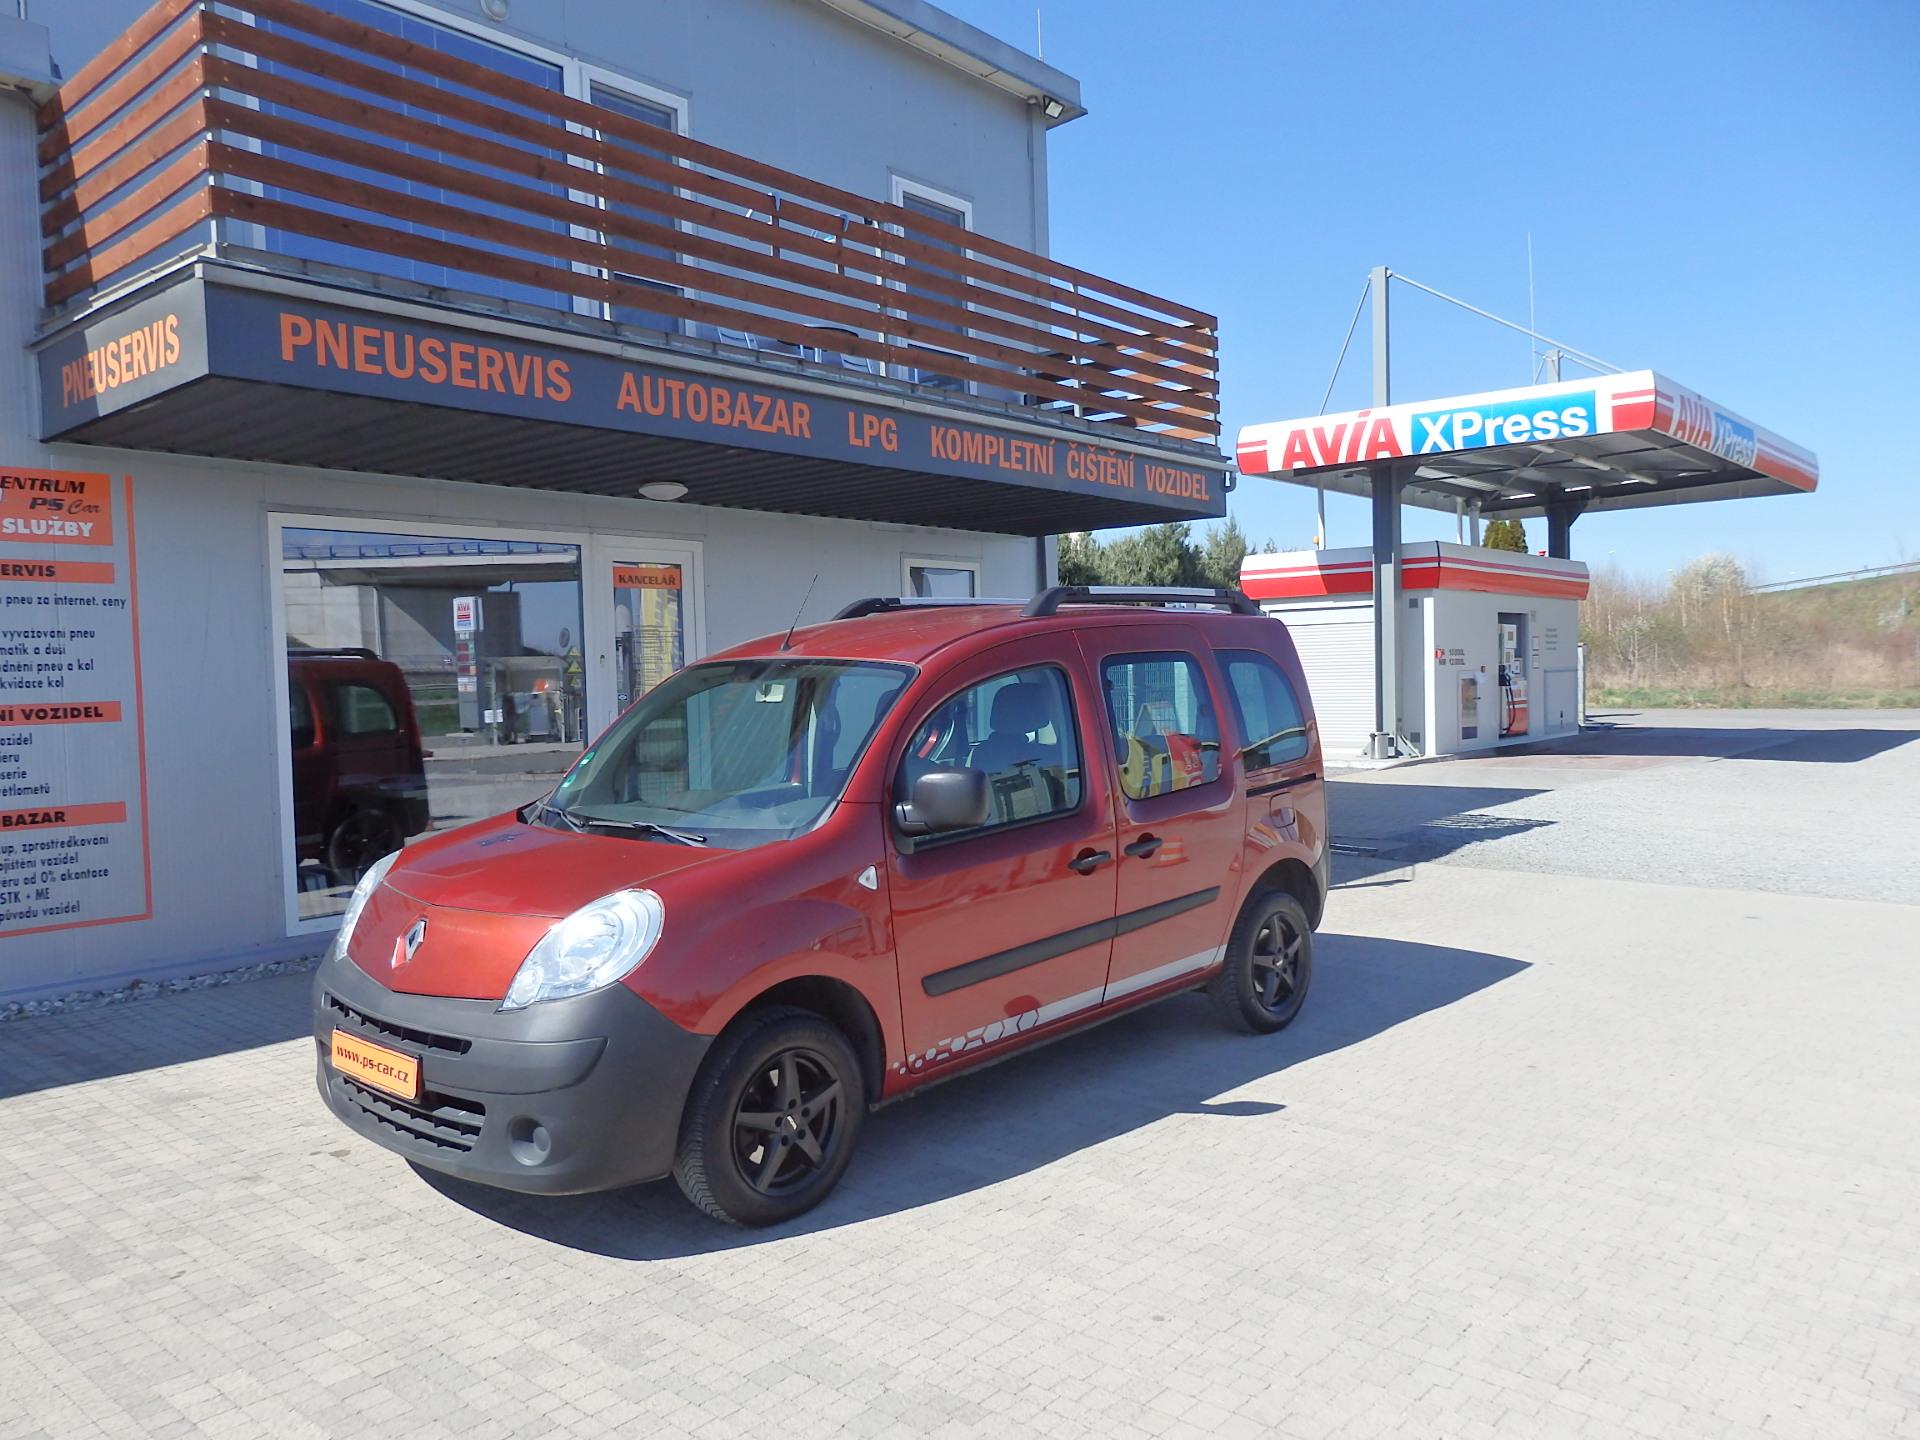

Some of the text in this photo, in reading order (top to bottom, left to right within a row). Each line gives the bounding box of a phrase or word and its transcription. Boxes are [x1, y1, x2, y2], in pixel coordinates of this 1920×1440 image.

[62, 314, 181, 408] PNEUSERVIS
[279, 312, 1210, 501] PNEUSERVIS AUTOBAZAR LPG KOMPLETNÍ ČIŠTĚNÍ VOZIDEL
[1418, 406, 1589, 456] XPress
[29, 497, 102, 515] PS Car
[1, 516, 94, 537] SLUŽBY
[618, 574, 676, 586] KANCELÁŘ
[6, 596, 33, 608] pneu
[37, 597, 50, 605] za
[102, 597, 127, 609] ceny
[70, 630, 95, 641] pneu
[37, 663, 63, 674] pneu
[77, 658, 94, 671] kol
[47, 676, 64, 688] kol
[21, 706, 104, 720] VOZIDEL
[2, 811, 66, 827] BAZAR
[41, 852, 79, 867] vozidel
[24, 872, 36, 885] od
[60, 868, 109, 882] akontace
[42, 900, 80, 916] vozidel
[337, 1046, 409, 1083] www.ps-car.cz
